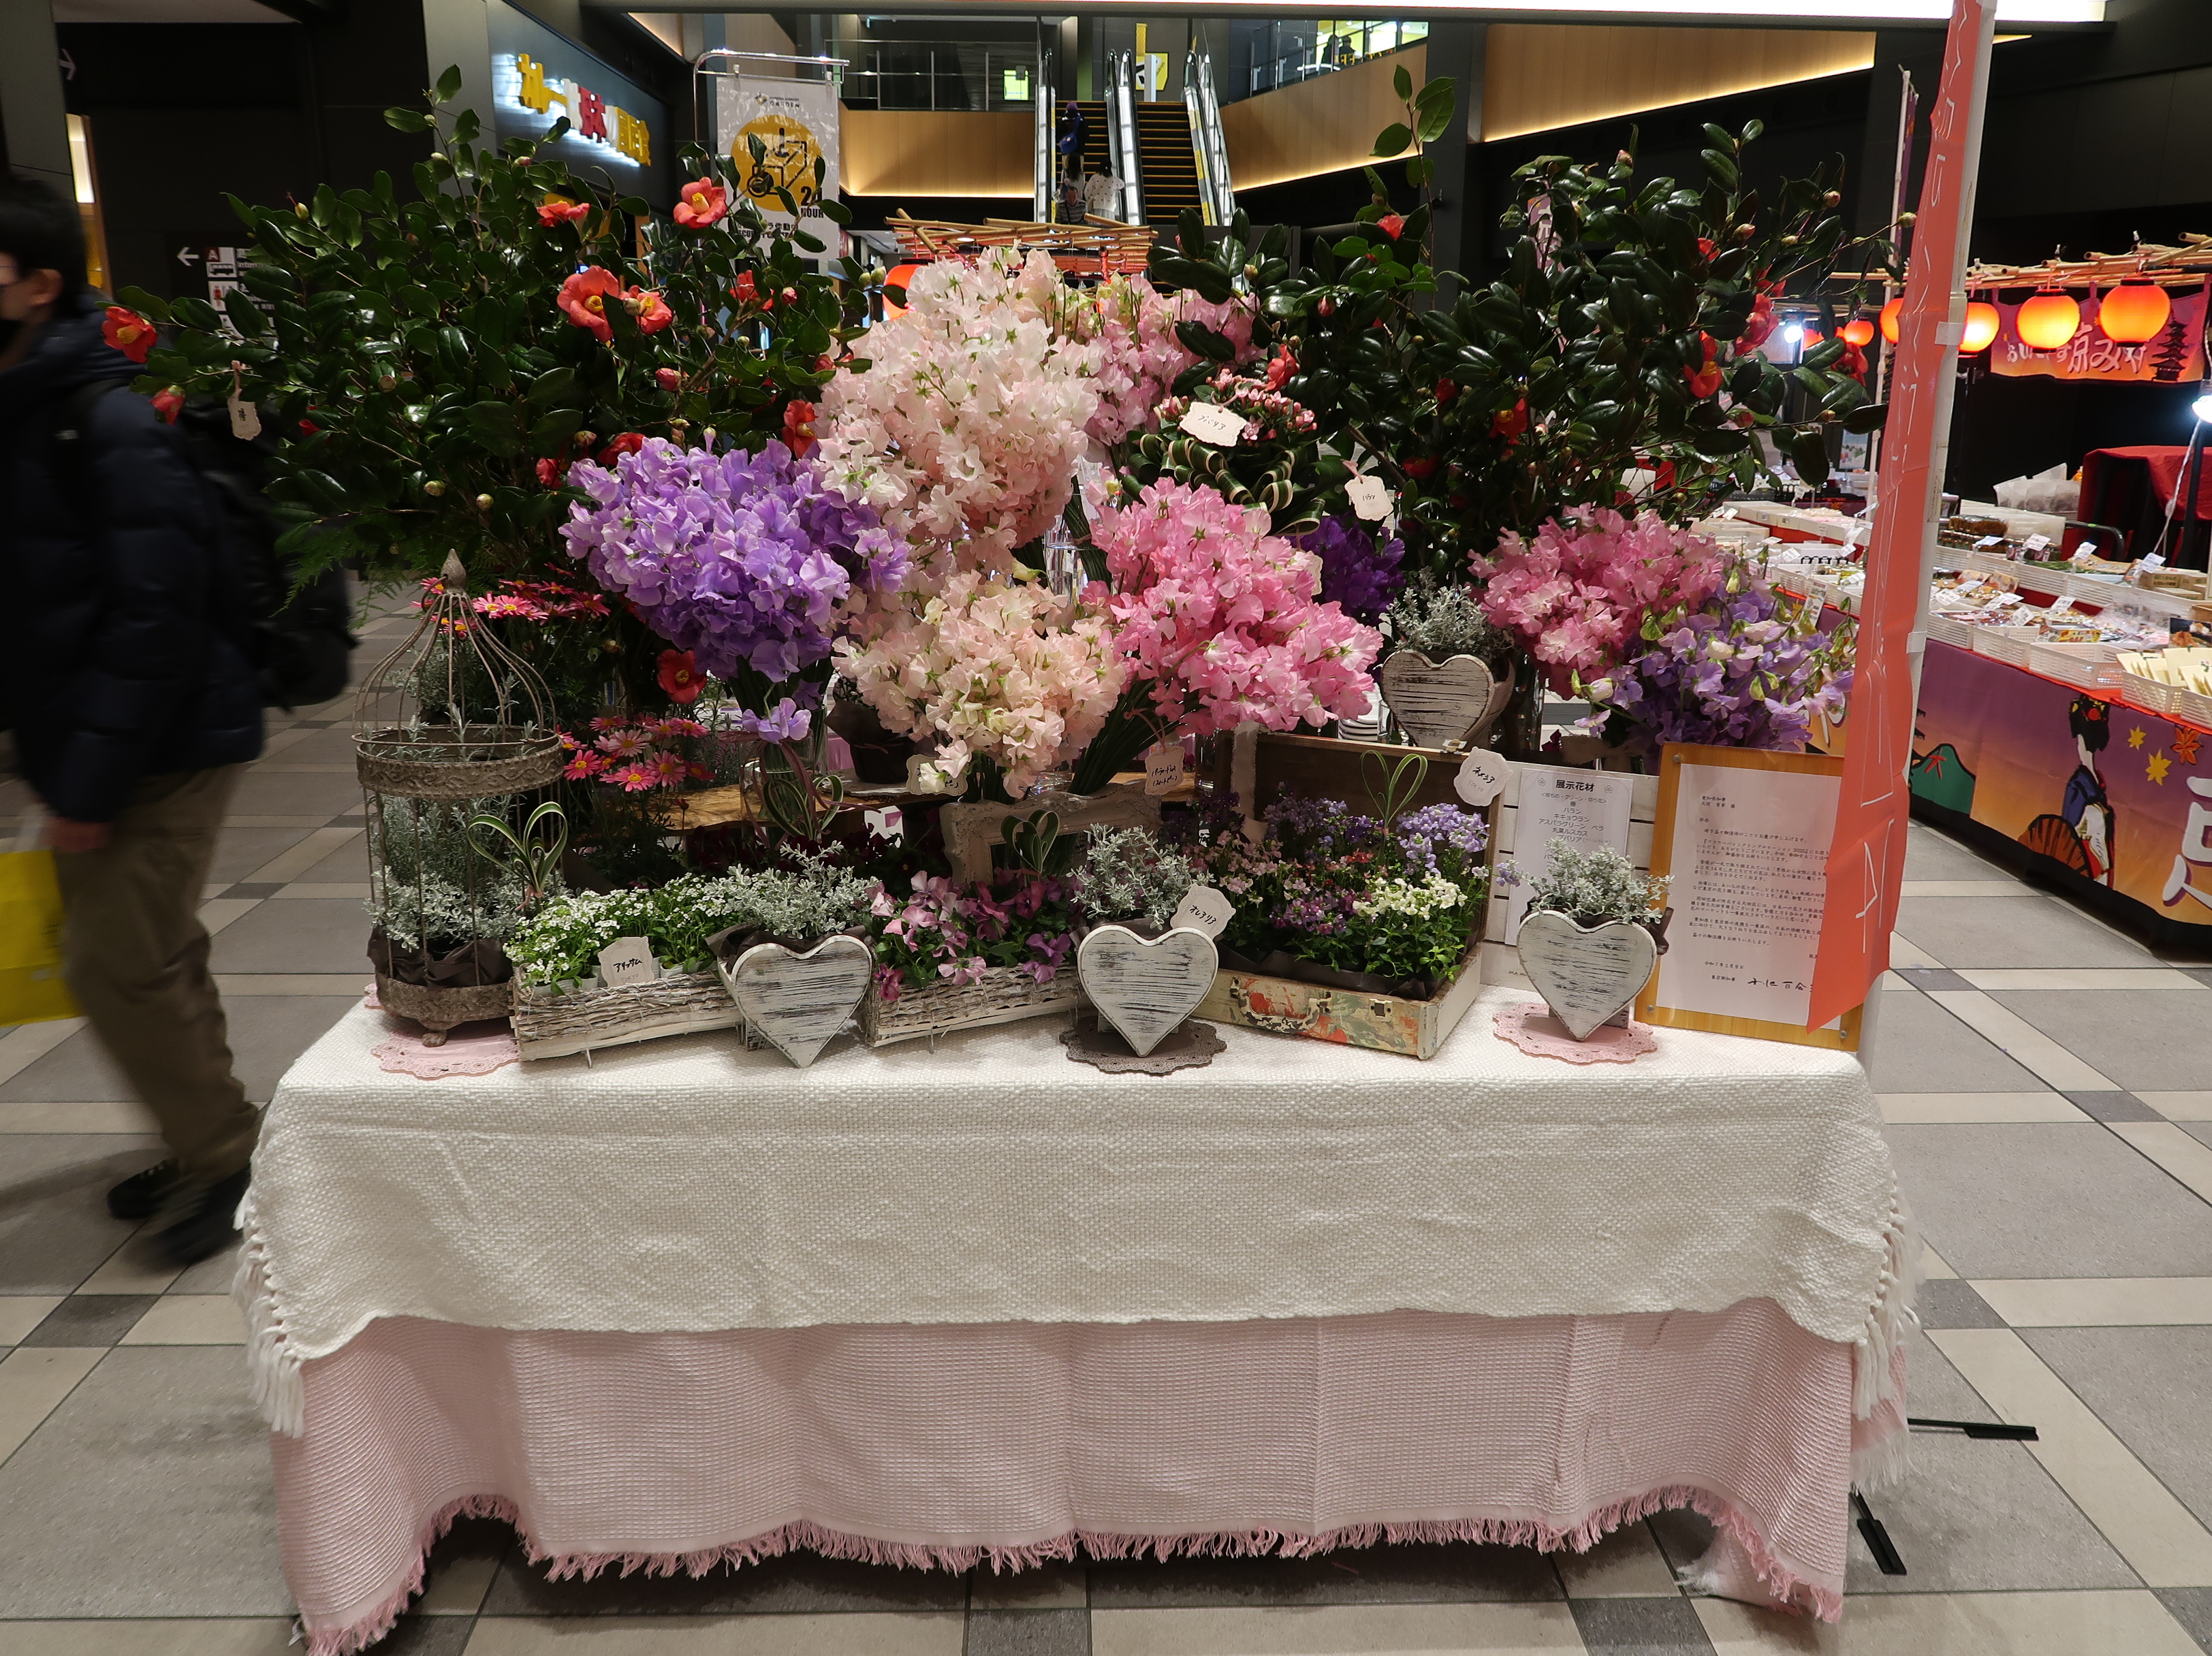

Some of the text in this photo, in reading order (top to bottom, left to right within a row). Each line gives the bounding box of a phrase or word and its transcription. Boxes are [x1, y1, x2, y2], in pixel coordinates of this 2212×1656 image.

[208, 249, 219, 261] A
[1197, 415, 1227, 430] ブバリア
[1472, 766, 1496, 784] ネメシア
[1468, 780, 1484, 793] TOKYO
[1555, 780, 1594, 791] 展示花材
[1553, 814, 1590, 822] キキョウラン
[1190, 905, 1216, 925] オレアリア
[613, 958, 643, 972] アリッサム
[620, 974, 639, 983] TOKYO
